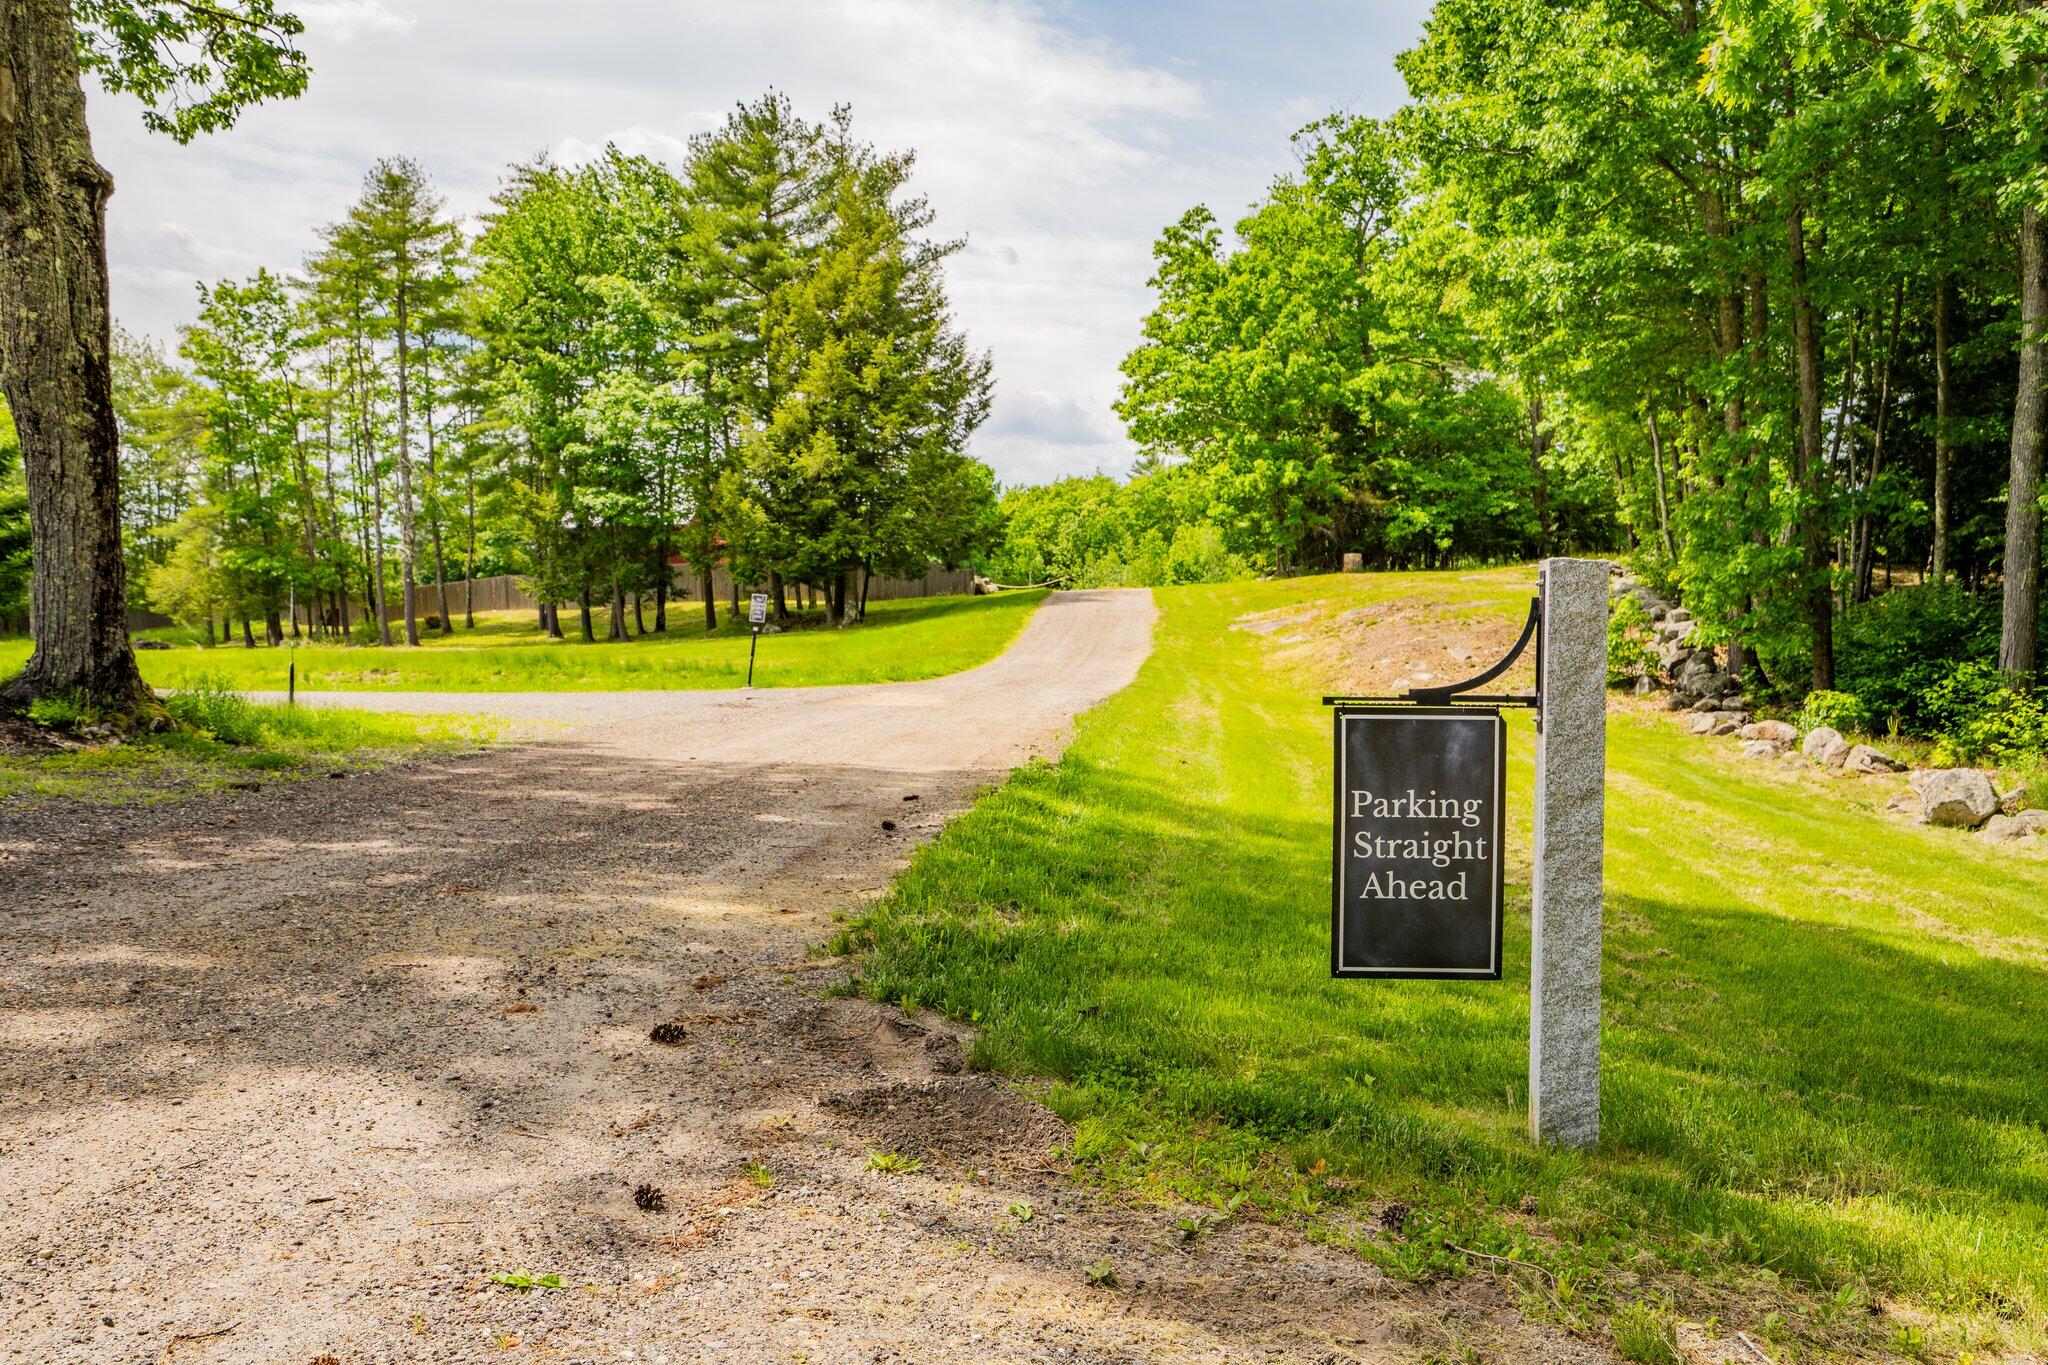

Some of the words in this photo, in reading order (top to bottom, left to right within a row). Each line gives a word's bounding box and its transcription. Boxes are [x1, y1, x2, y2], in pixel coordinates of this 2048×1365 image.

[1350, 789, 1483, 827] Parking
[1353, 830, 1488, 868] Straight
[1359, 870, 1468, 901] Ahead
